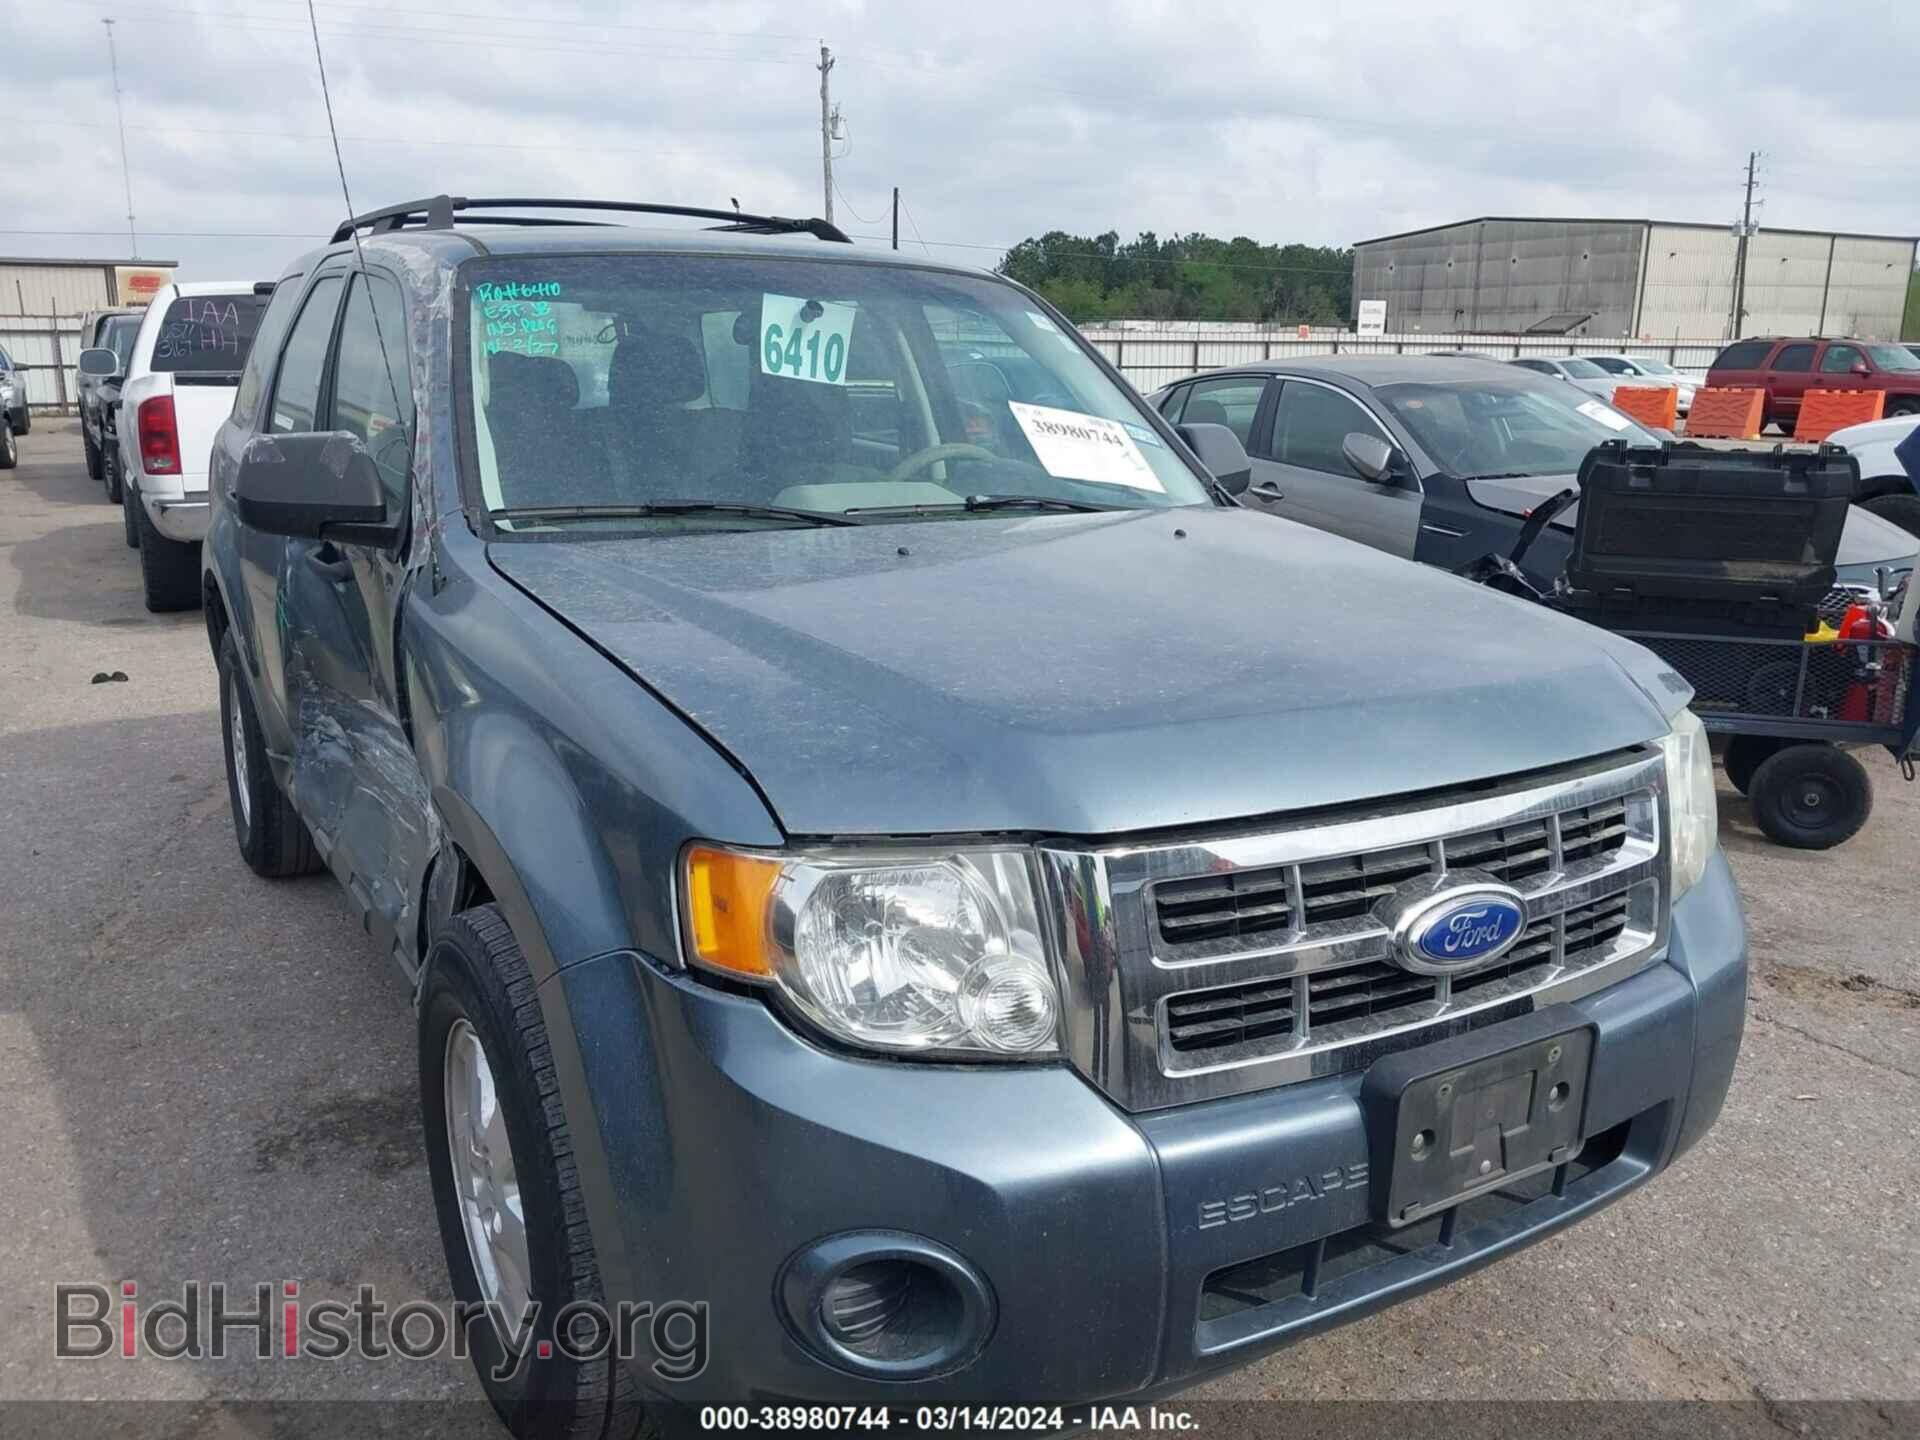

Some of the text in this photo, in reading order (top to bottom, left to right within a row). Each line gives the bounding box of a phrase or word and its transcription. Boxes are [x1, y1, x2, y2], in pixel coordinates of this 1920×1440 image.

[183, 299, 239, 325] IAA
[765, 323, 844, 382] 6410
[1031, 418, 1124, 447] 38980744
[1444, 909, 1503, 952] Ford
[1199, 1163, 1369, 1229] ESCAPE
